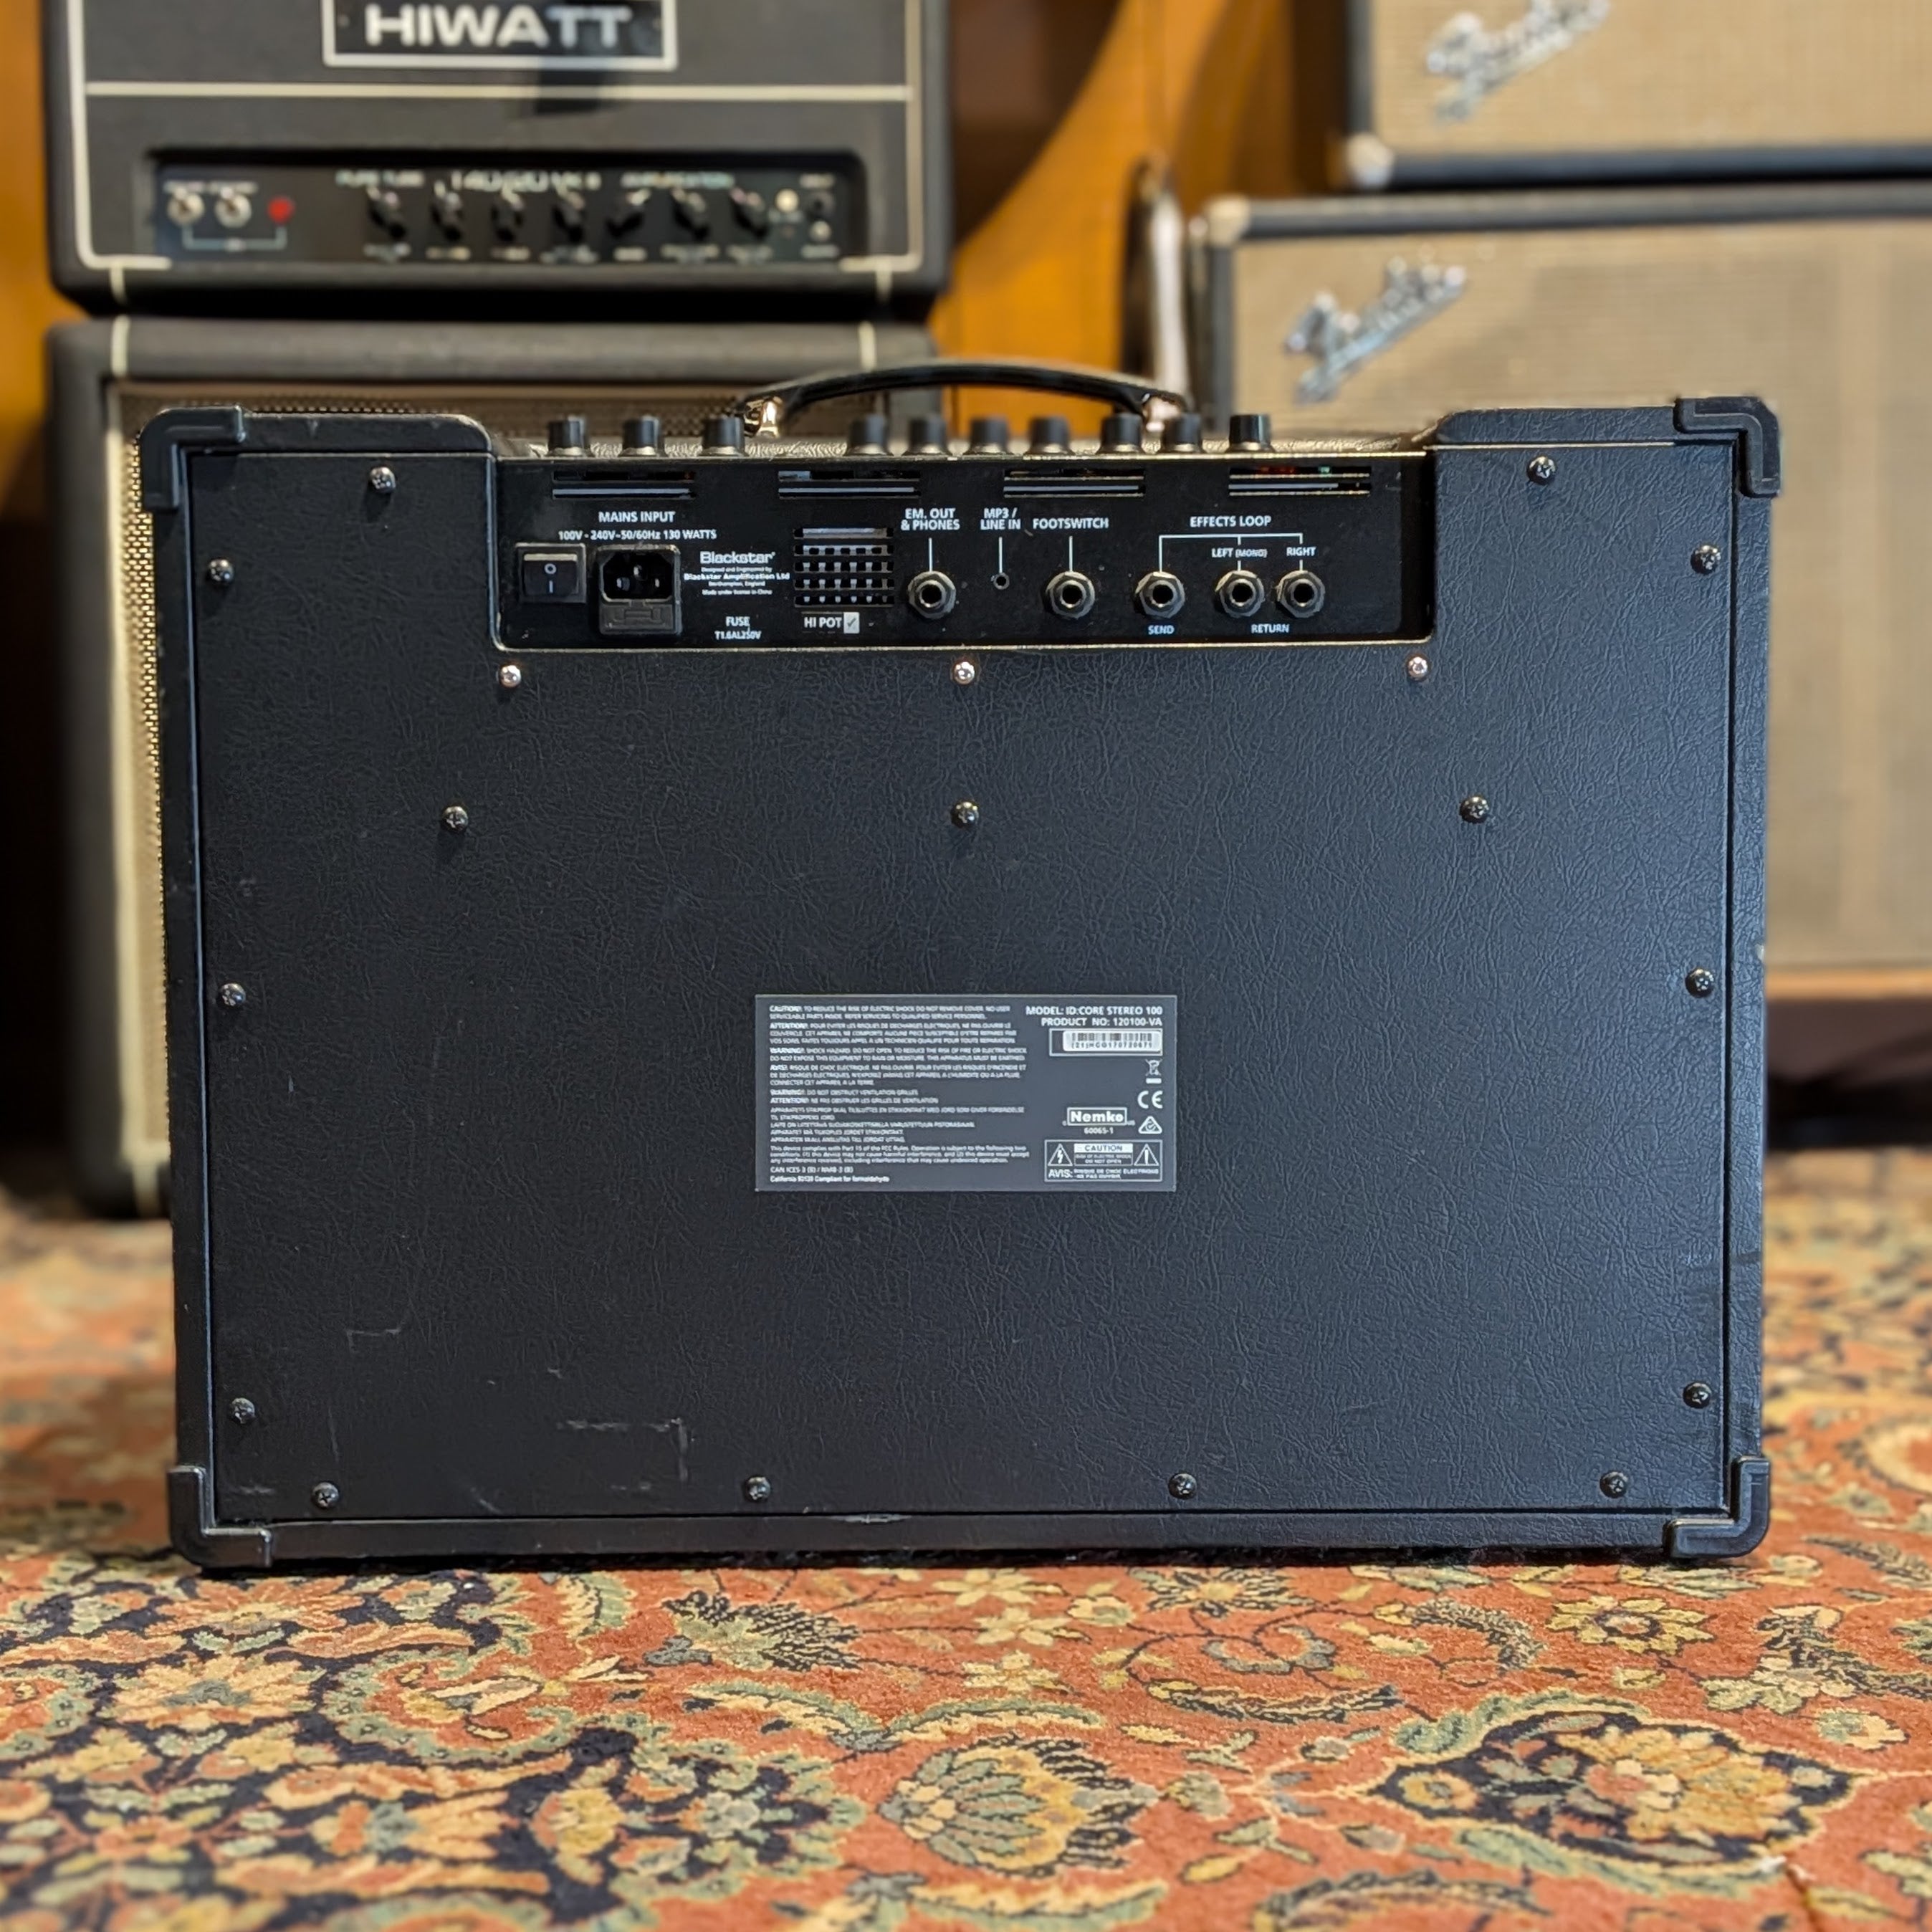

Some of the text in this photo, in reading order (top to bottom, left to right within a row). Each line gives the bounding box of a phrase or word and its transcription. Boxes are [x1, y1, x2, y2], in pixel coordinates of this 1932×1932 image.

[364, 3, 632, 47] HIWATT
[598, 511, 676, 522] MAINS INPUT
[905, 508, 956, 519] EM. OUT
[984, 507, 1018, 518] MP3 /
[900, 519, 960, 530] & PHONES
[980, 519, 1021, 530] LINE IN
[1033, 517, 1109, 530] FOOTSWITCH
[1190, 515, 1272, 527] EFFECTS LOOP
[558, 531, 583, 540] 100V
[664, 530, 680, 540] 130
[682, 529, 717, 540] WATTS
[1211, 547, 1234, 558] LEFT
[1286, 546, 1316, 556] RIGHT
[699, 551, 773, 564] Blackstar
[726, 616, 750, 626] FUSE
[804, 617, 842, 628] HI POT
[1148, 625, 1175, 635] SEND
[1251, 623, 1289, 633] RETURN
[1025, 1005, 1162, 1015] MODEL: ID:CORE STEREO 100
[1041, 1018, 1162, 1026] PRODUCT NO: 120100-VA
[1070, 1111, 1124, 1123] Nemko
